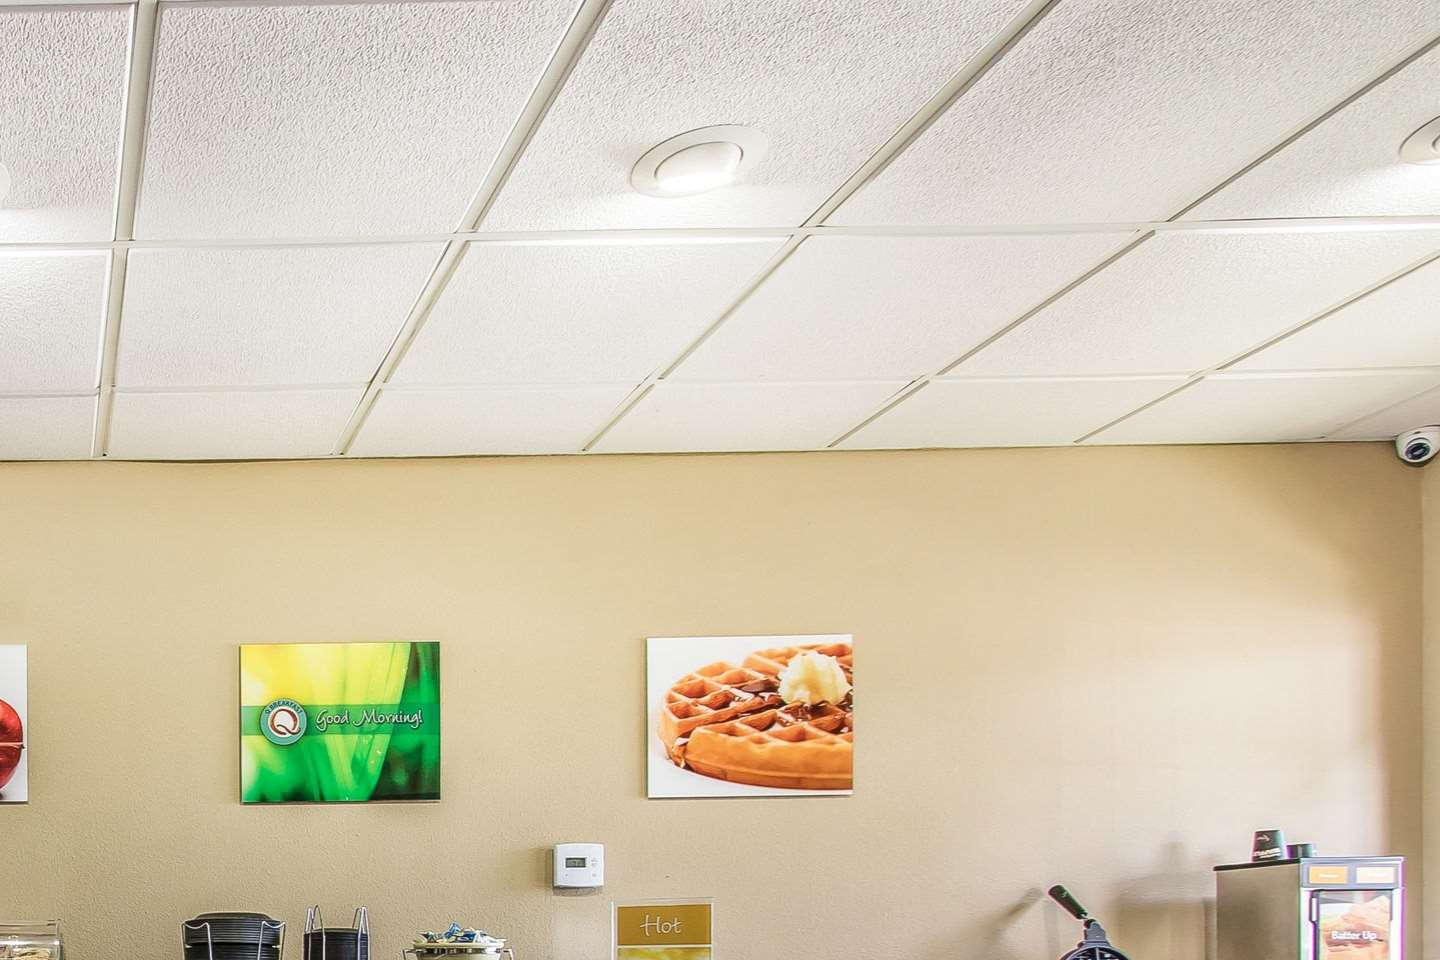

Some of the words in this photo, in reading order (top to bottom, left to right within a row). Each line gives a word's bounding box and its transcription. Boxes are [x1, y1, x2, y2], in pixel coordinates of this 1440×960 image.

[316, 709, 349, 732] Good
[352, 709, 423, 729] Morning!
[640, 914, 683, 937] Hot
[1331, 931, 1361, 941] Batter
[1362, 930, 1378, 941] Up
